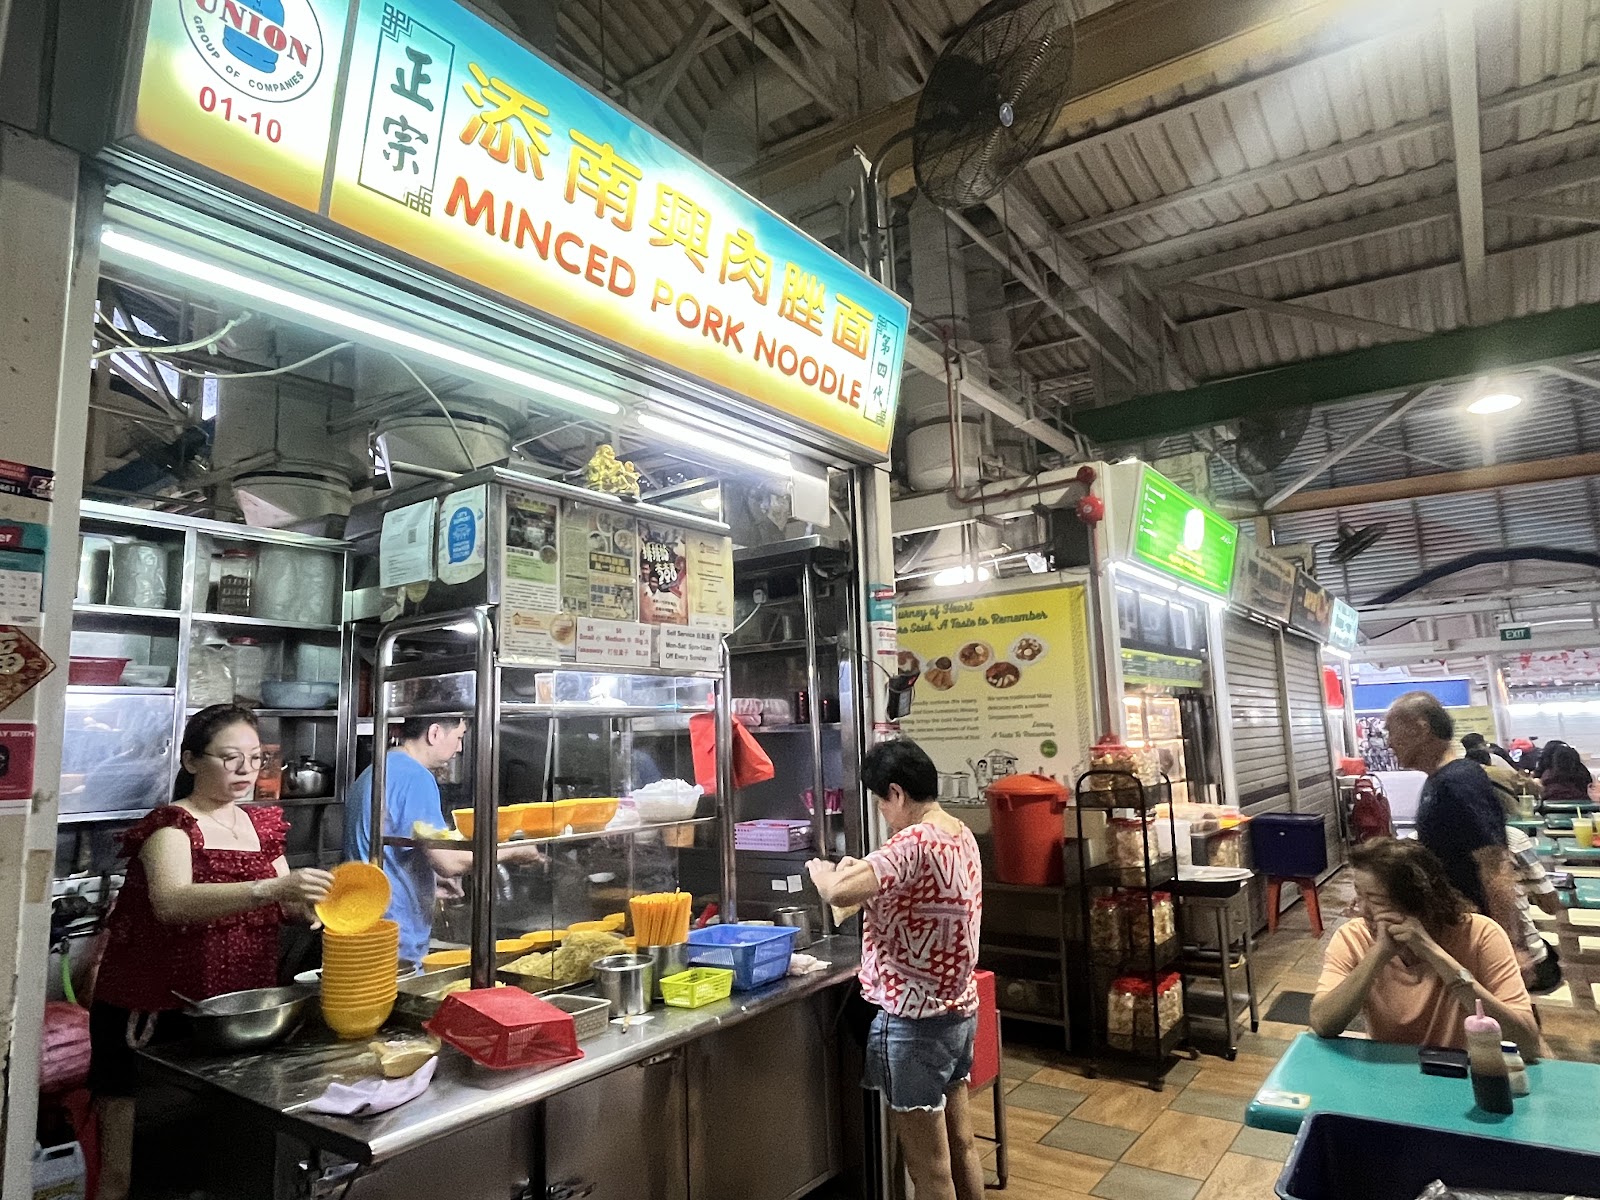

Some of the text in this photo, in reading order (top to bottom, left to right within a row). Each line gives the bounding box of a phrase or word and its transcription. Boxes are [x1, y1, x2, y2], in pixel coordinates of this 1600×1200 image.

[193, 15, 304, 92] GROUP OF COMPANIES
[199, 86, 282, 144] 01-10
[383, 46, 433, 175] 正宗
[444, 176, 862, 410] MINCED PORK NOODLE
[942, 601, 975, 614] Heart
[937, 619, 949, 630] A
[951, 617, 976, 629] Taste
[977, 615, 989, 626] to
[991, 610, 1048, 625] Remember
[605, 635, 626, 643] Medium
[635, 637, 644, 646] Big
[666, 629, 677, 637] Self
[677, 630, 695, 639] Service
[1505, 630, 1525, 639] EXIT
[578, 646, 603, 655] Takeaway
[674, 653, 688, 661] Every
[689, 654, 707, 662] Sunday
